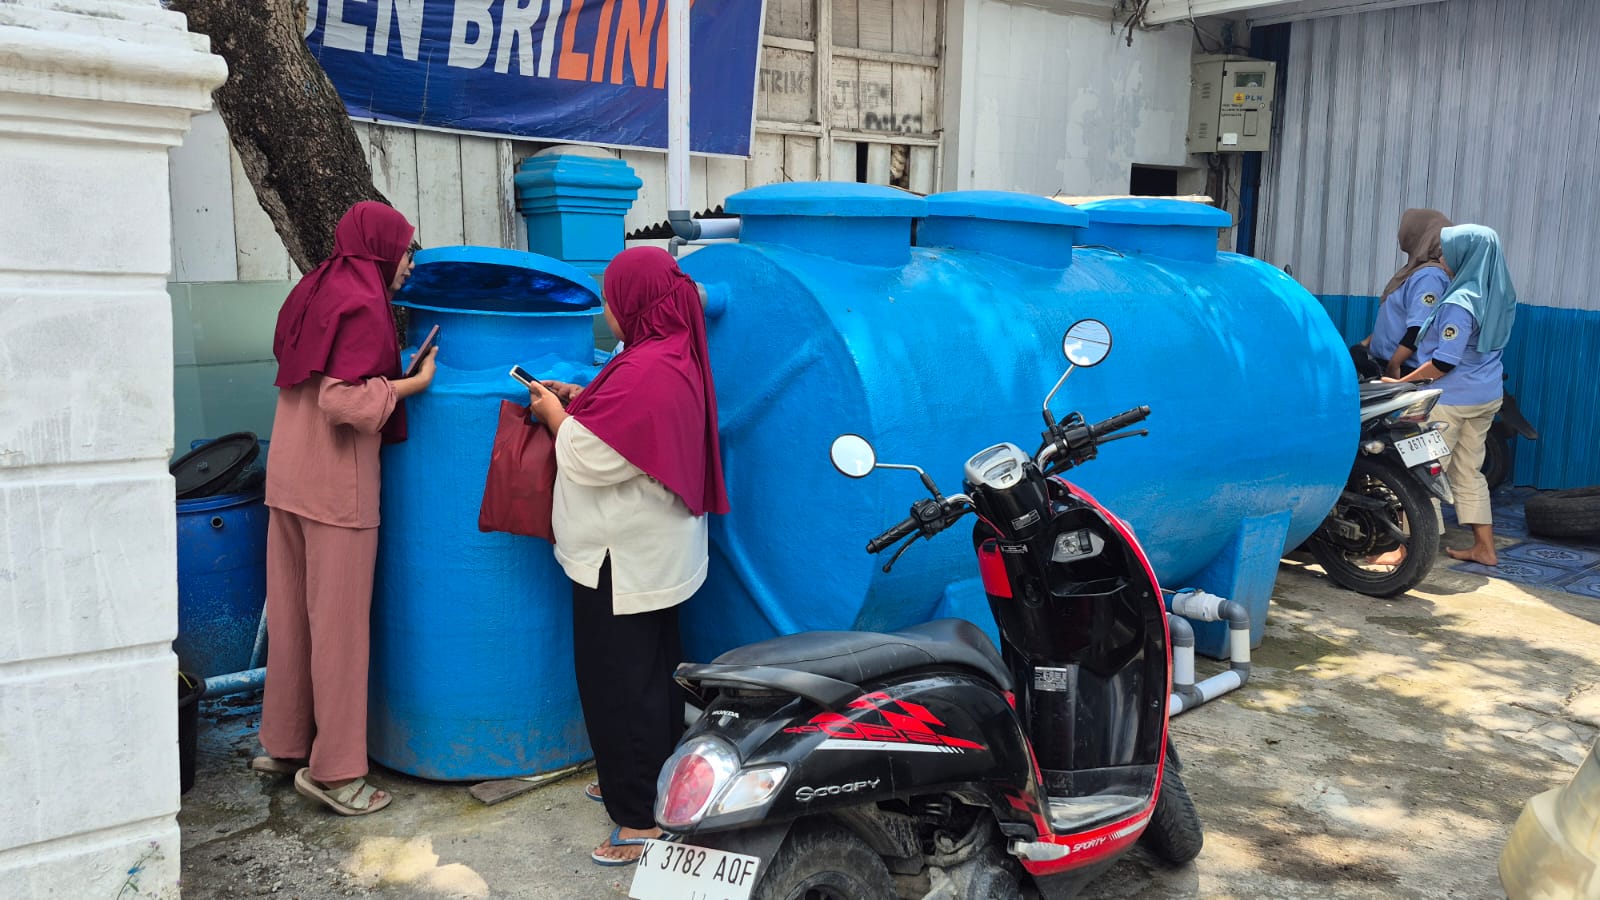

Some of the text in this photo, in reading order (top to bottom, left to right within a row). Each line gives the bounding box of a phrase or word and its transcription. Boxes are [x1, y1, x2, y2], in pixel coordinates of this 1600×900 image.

[304, 0, 424, 61] EN
[640, 842, 655, 867] K
[660, 846, 707, 877] 3782
[1071, 837, 1107, 853] SPORTY
